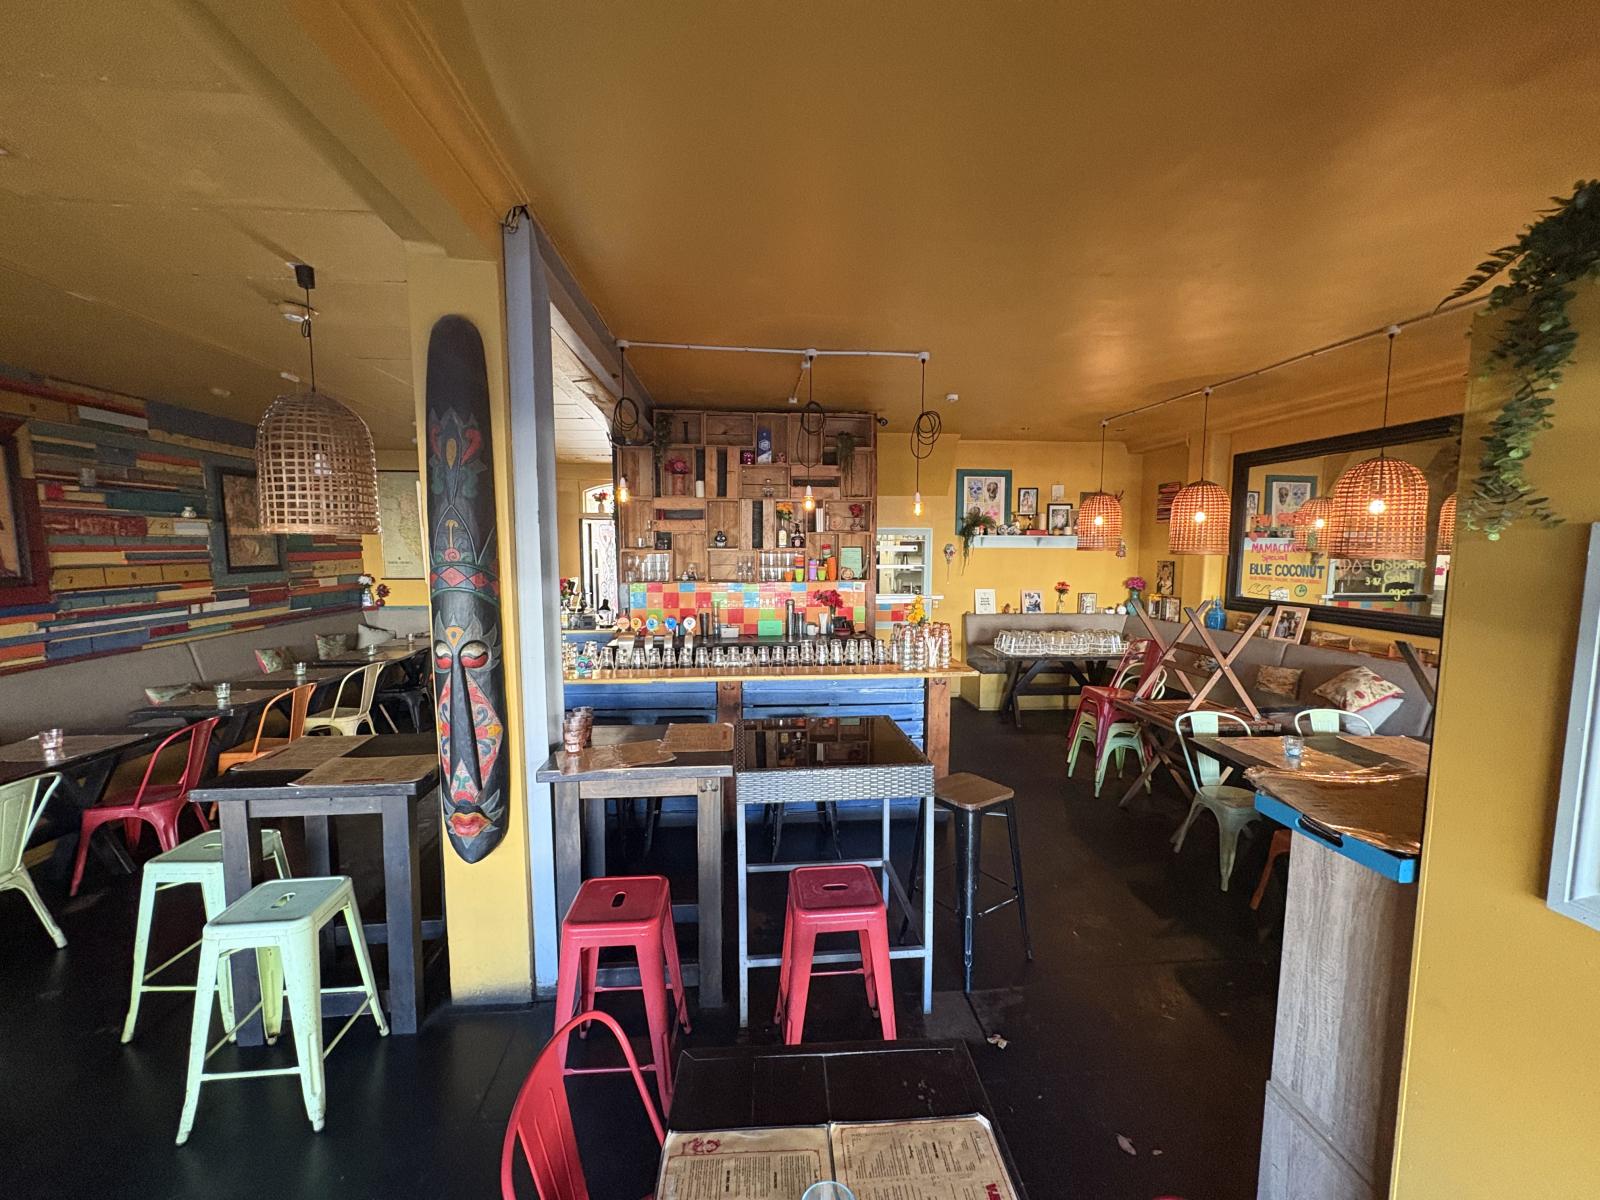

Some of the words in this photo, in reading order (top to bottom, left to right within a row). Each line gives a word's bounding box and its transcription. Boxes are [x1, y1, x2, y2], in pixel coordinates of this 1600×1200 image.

[1249, 563, 1273, 576] BLUE
[1275, 564, 1325, 579] COCONUT
[1371, 559, 1427, 572] Gisborne
[1382, 583, 1414, 601] Lager
